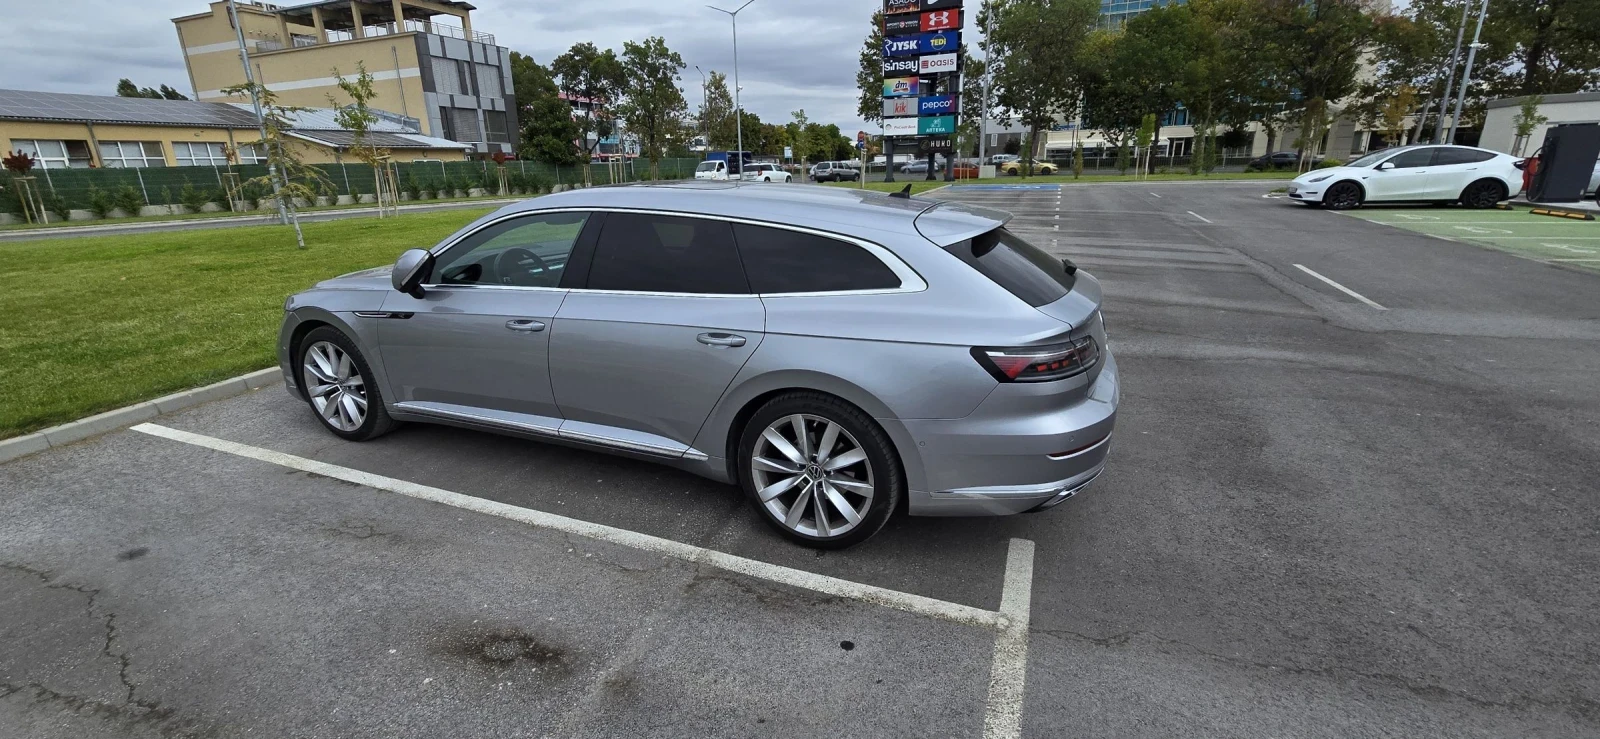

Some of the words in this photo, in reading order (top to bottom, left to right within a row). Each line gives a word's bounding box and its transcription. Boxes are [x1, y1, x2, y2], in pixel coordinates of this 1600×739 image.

[891, 40, 918, 51] JYSK
[930, 38, 947, 46] TEDi
[884, 60, 918, 72] sinsay
[922, 101, 950, 110] pepco
